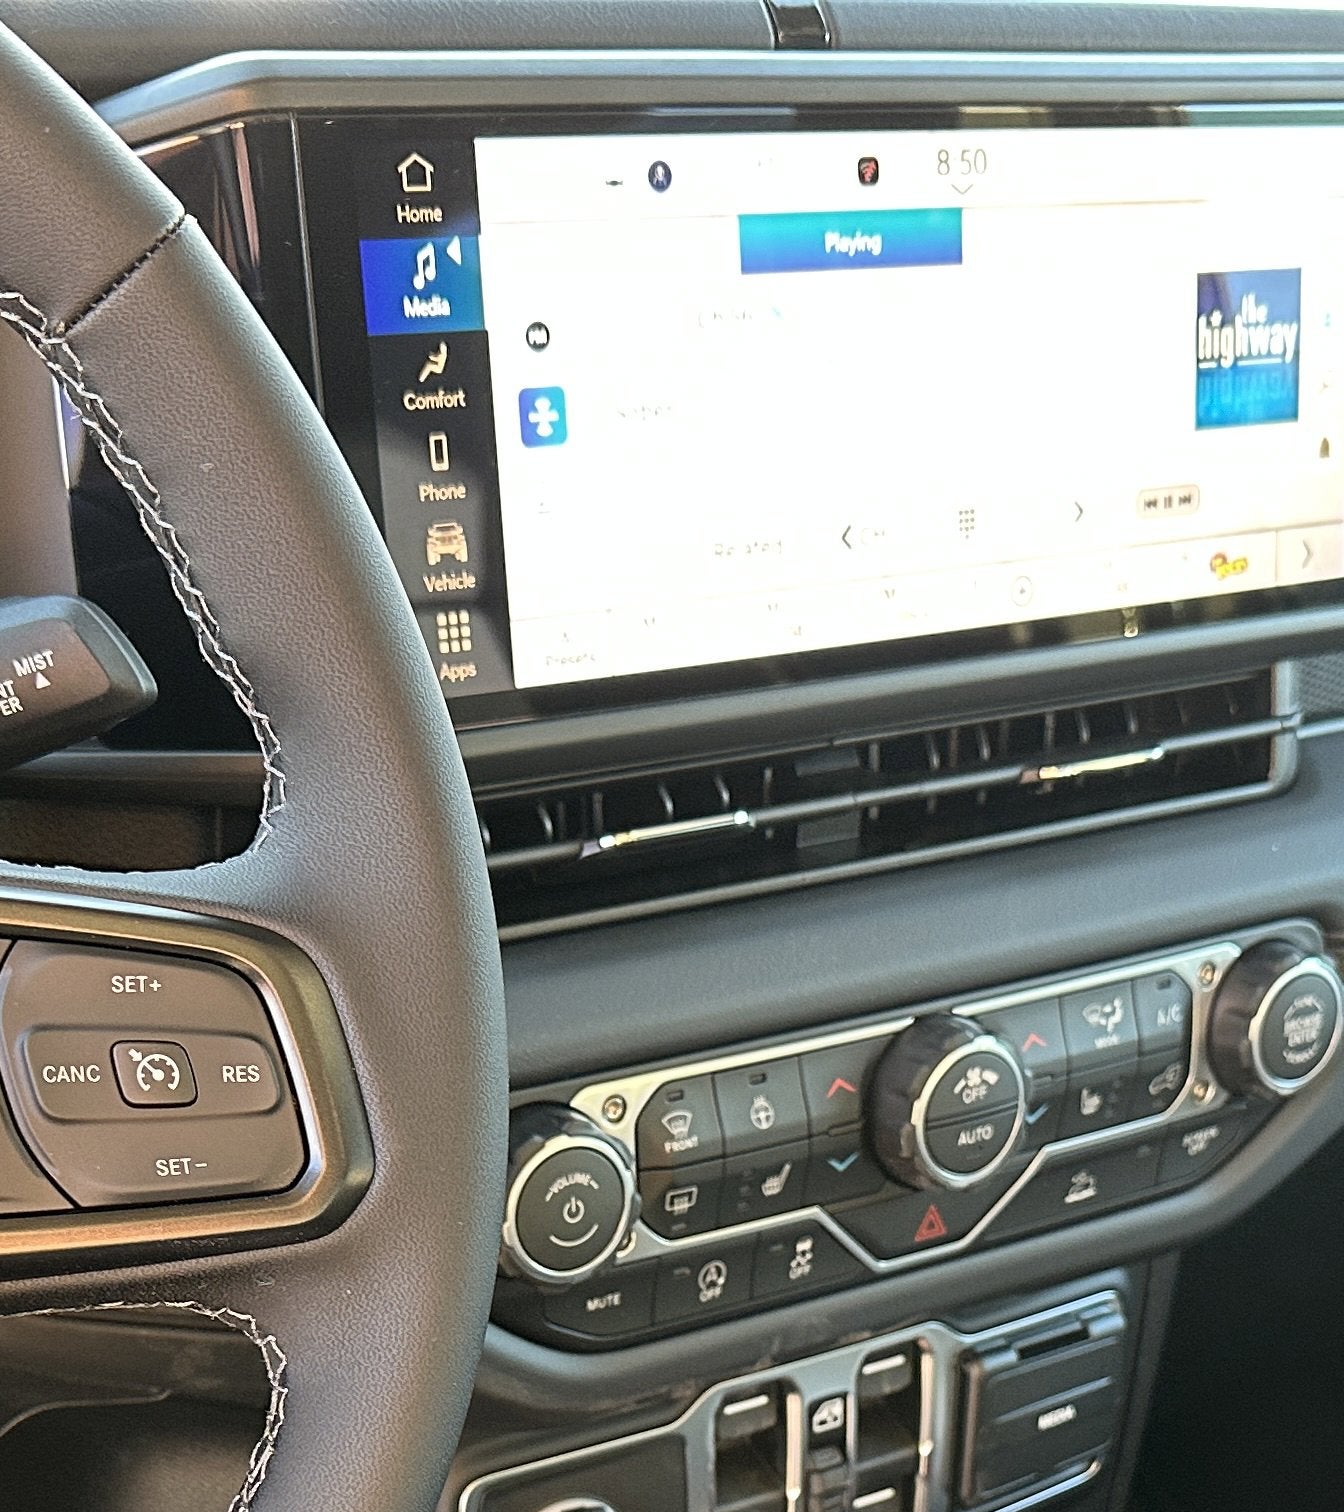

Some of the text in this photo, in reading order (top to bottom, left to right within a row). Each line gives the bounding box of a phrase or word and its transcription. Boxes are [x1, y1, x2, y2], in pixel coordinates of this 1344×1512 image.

[936, 148, 987, 176] 850
[397, 203, 443, 223] Home
[824, 230, 883, 256] Playing
[403, 295, 451, 318] Media
[1241, 291, 1268, 324] the
[1198, 309, 1298, 369] highway
[403, 389, 466, 411] Comfort
[418, 481, 467, 502] Phone
[423, 571, 476, 593] Vehicle
[12, 650, 55, 677] MIST
[439, 662, 477, 682] Apps
[111, 975, 162, 994] SET+
[1157, 1003, 1182, 1027] A/C
[43, 1065, 260, 1084] CANC RES
[962, 1084, 988, 1104] OFF
[664, 1135, 698, 1153] FRONT
[957, 1123, 994, 1146] AUTO
[549, 1173, 590, 1194] VOLUME
[586, 1293, 621, 1311] MUTE
